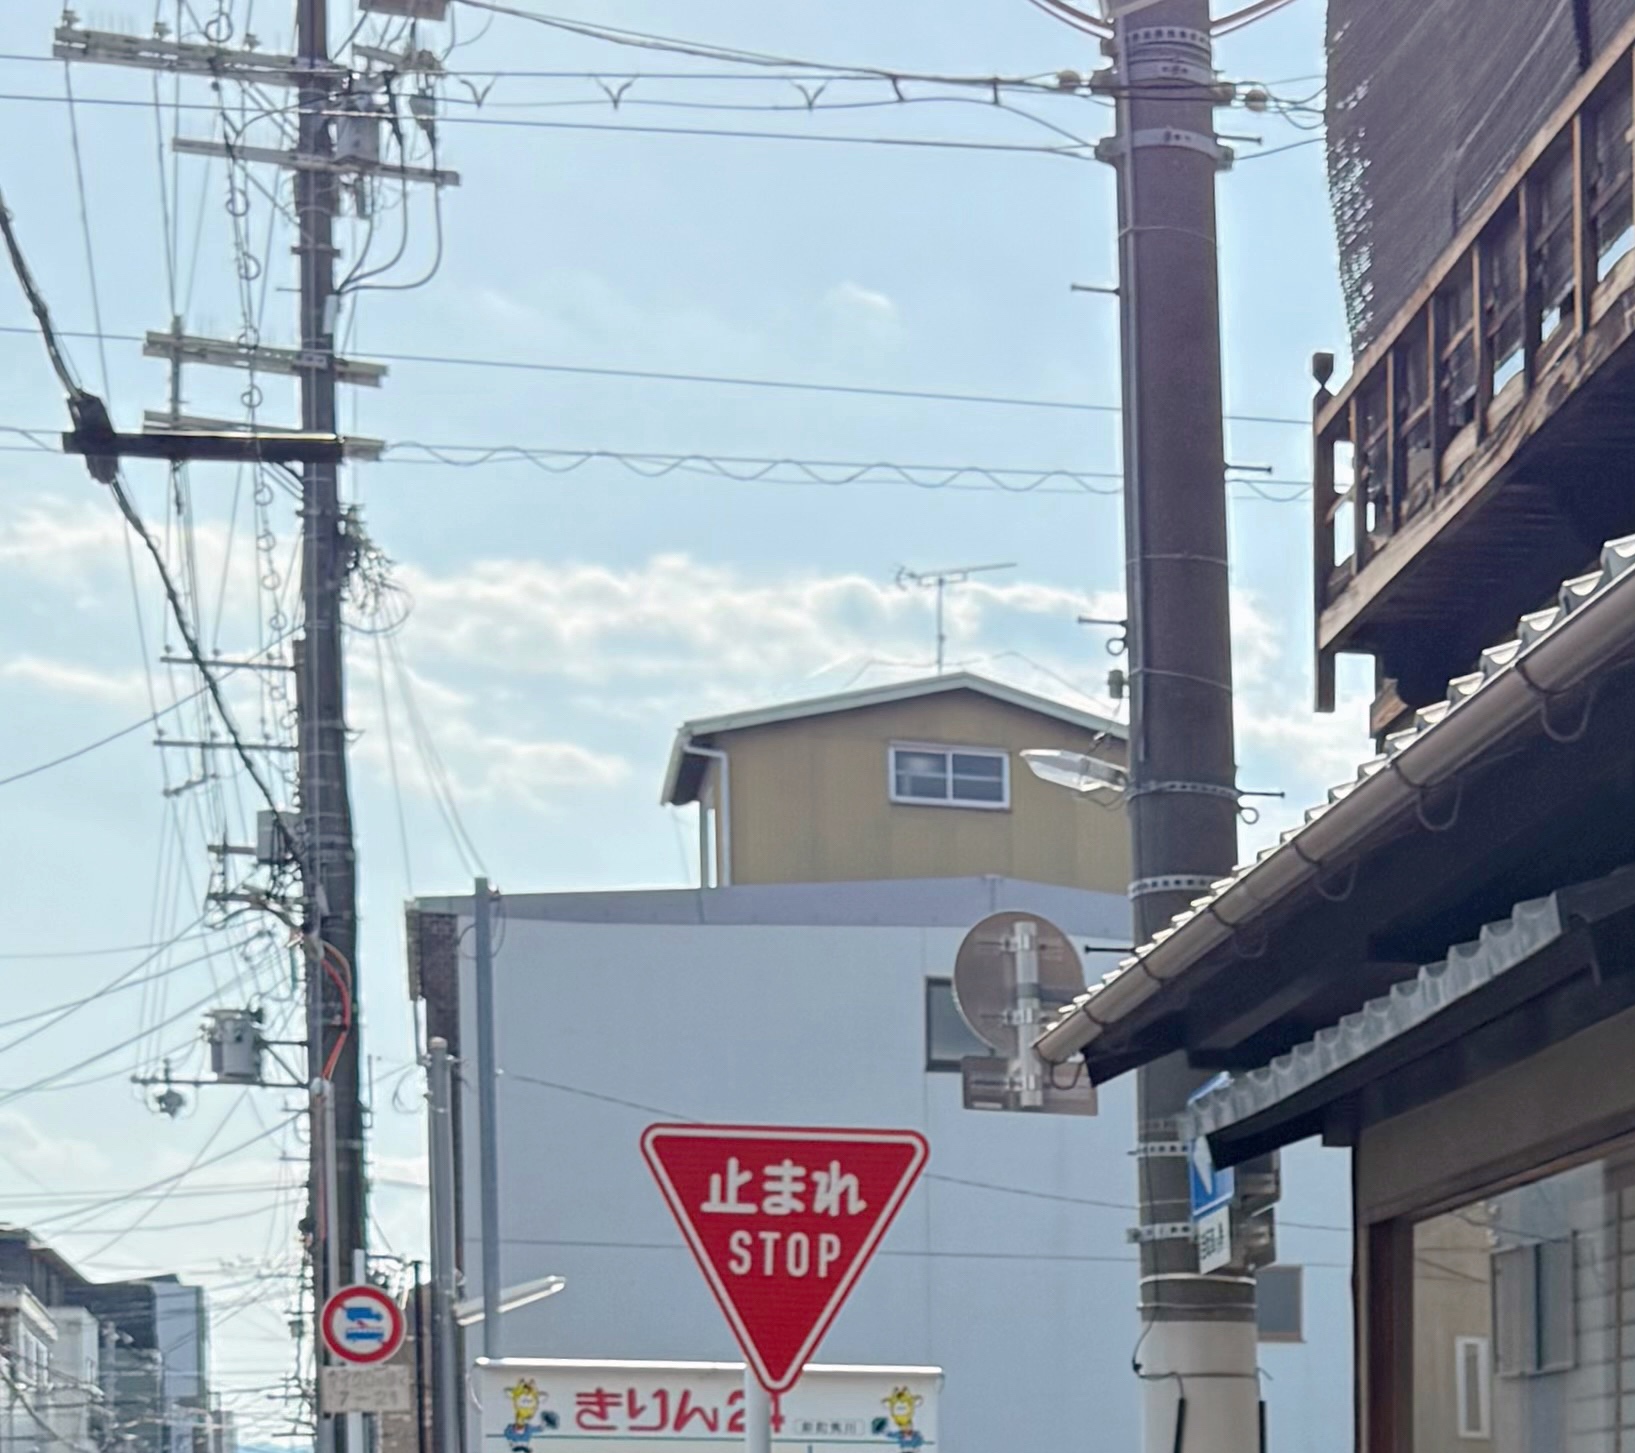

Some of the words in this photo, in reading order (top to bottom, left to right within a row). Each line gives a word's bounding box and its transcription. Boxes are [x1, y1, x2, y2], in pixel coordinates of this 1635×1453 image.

[700, 1156, 867, 1217] 止まれ
[728, 1230, 842, 1278] STOP
